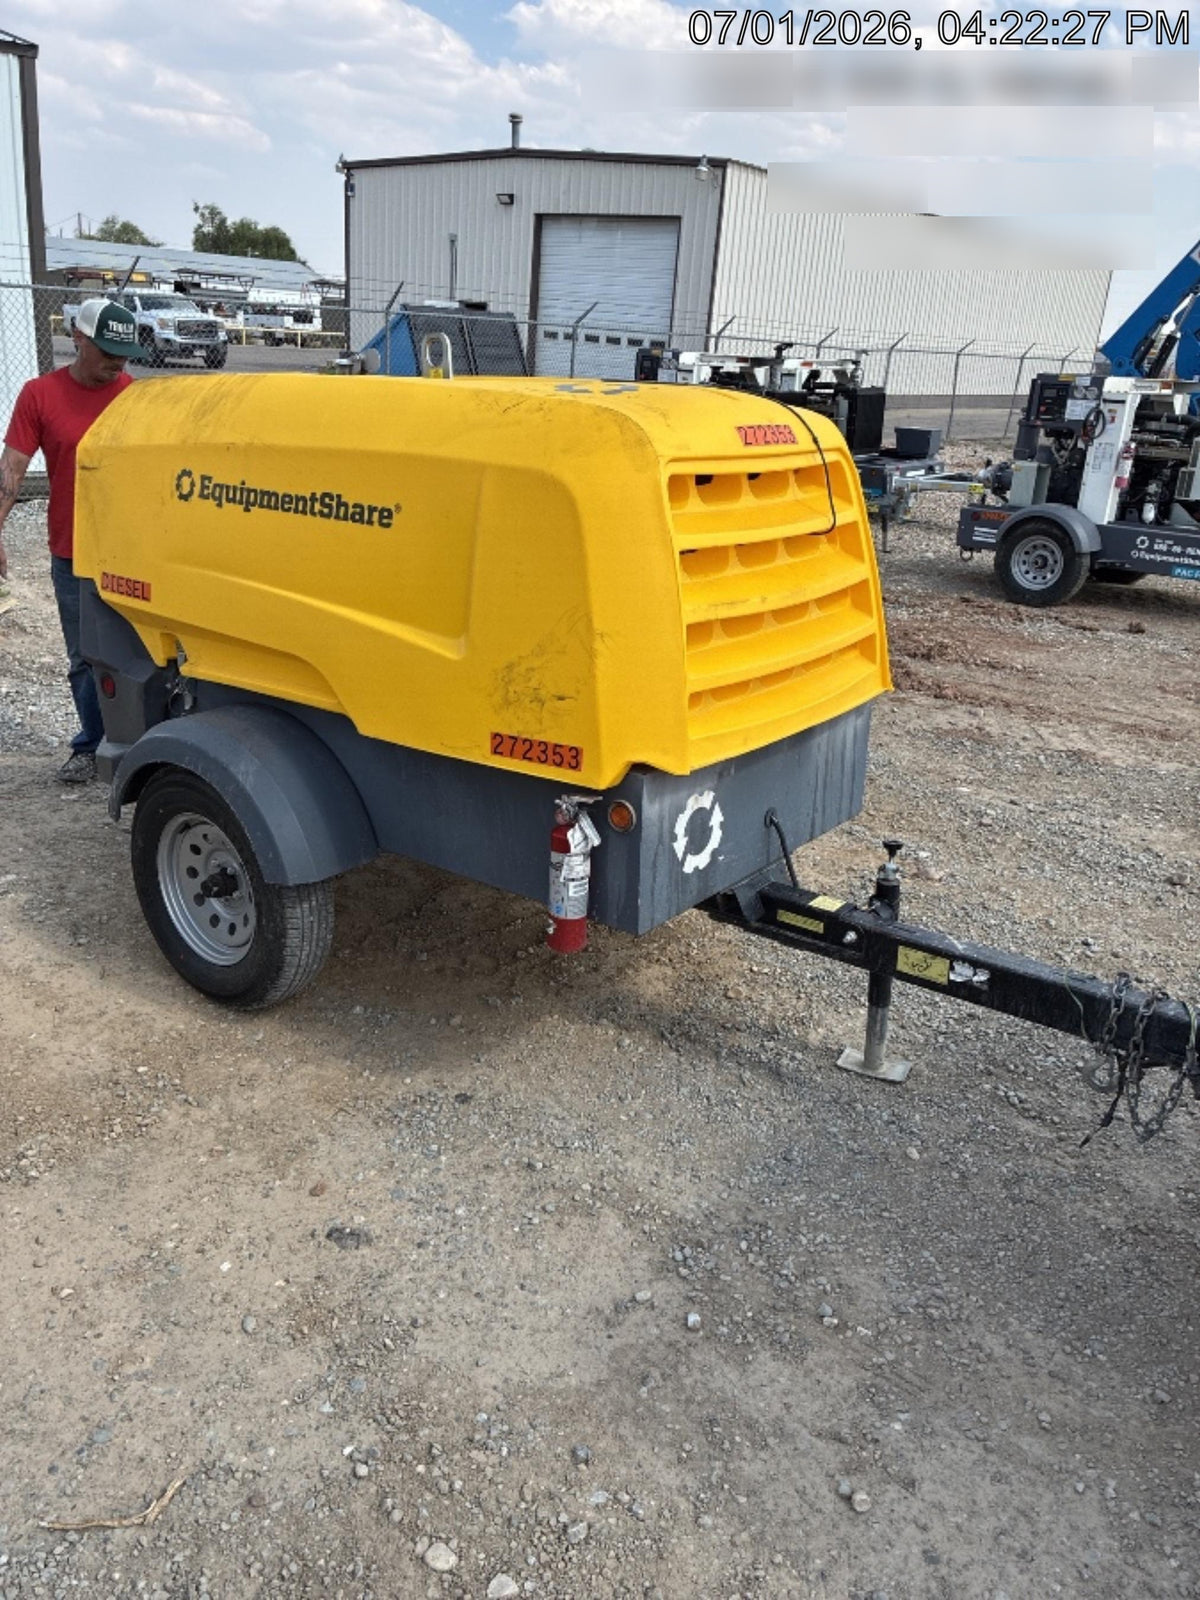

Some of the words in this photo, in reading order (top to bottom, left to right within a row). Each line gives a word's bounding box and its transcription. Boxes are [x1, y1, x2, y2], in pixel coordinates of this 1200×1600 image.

[736, 424, 796, 445] 272353
[101, 571, 151, 602] DIESEL
[491, 732, 581, 771] 272353
